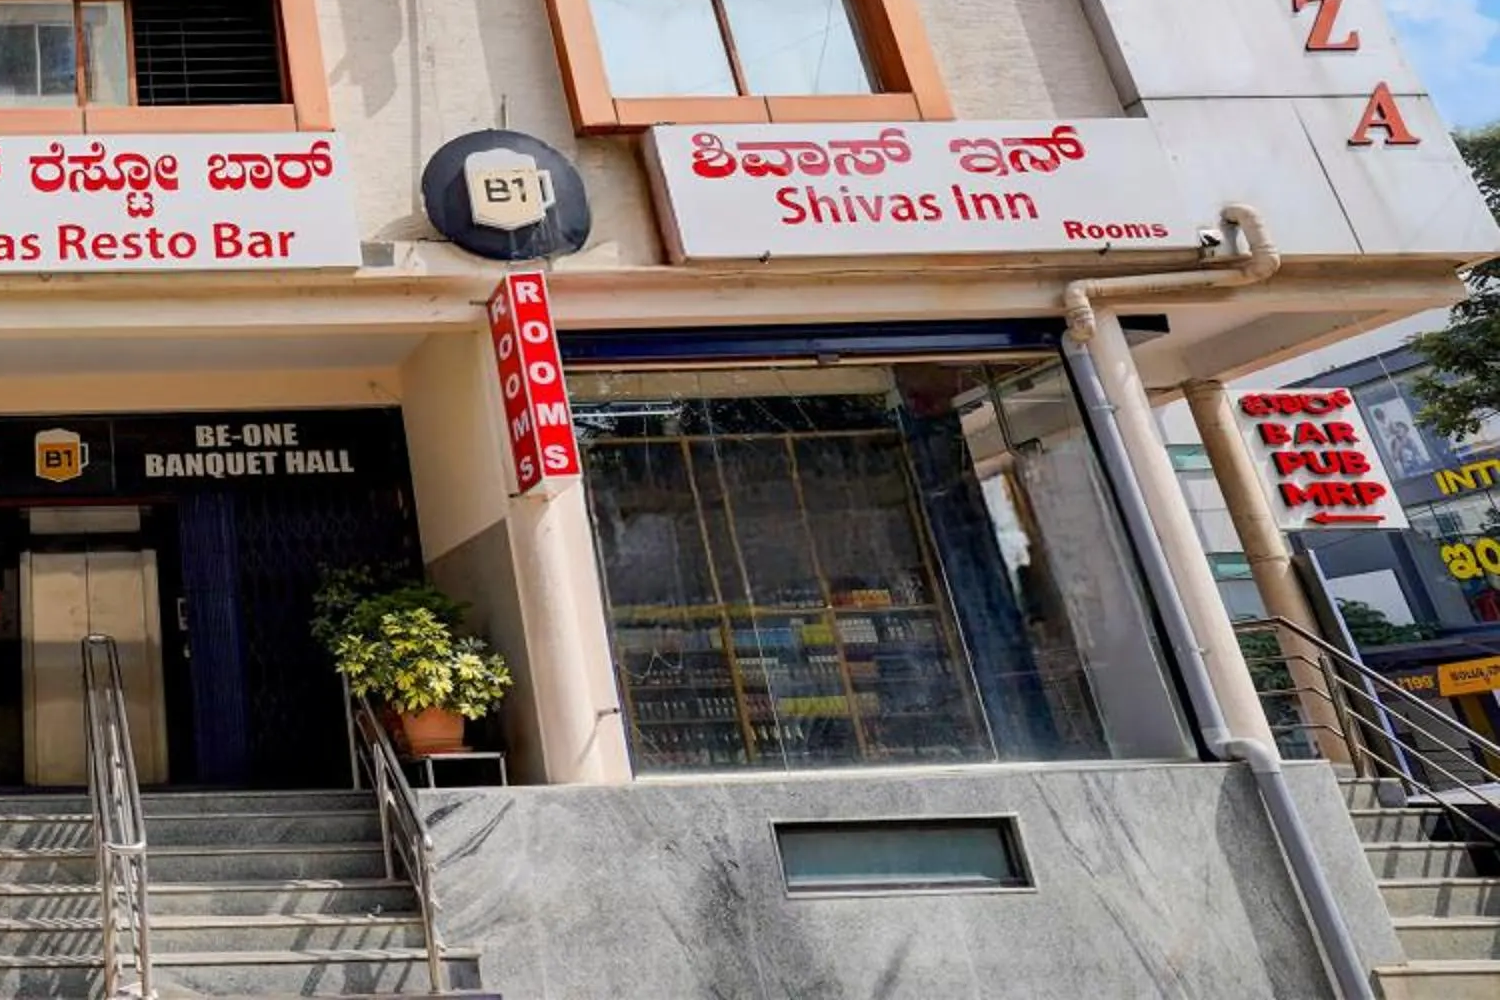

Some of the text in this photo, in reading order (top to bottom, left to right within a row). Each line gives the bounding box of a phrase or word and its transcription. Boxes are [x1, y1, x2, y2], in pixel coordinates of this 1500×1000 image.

[207, 140, 331, 192] ಬಾರ್
[691, 125, 1085, 178] ಶಿವಾಸ್ ಇನ್
[484, 178, 528, 203] B1
[775, 184, 1039, 225] Shivas Inn
[59, 225, 197, 261] Resto
[214, 223, 296, 259] Bar
[1063, 220, 1169, 241] Rooms
[490, 295, 534, 481] ROOMS
[515, 281, 569, 469] ROOMS
[195, 423, 299, 447] BE-ONE
[1257, 422, 1360, 445] BAR
[45, 450, 73, 468] B1
[145, 449, 355, 478] BANQUET HALL
[1272, 451, 1371, 476] PUB
[1435, 459, 1500, 496] INT
[1278, 481, 1387, 507] MRP
